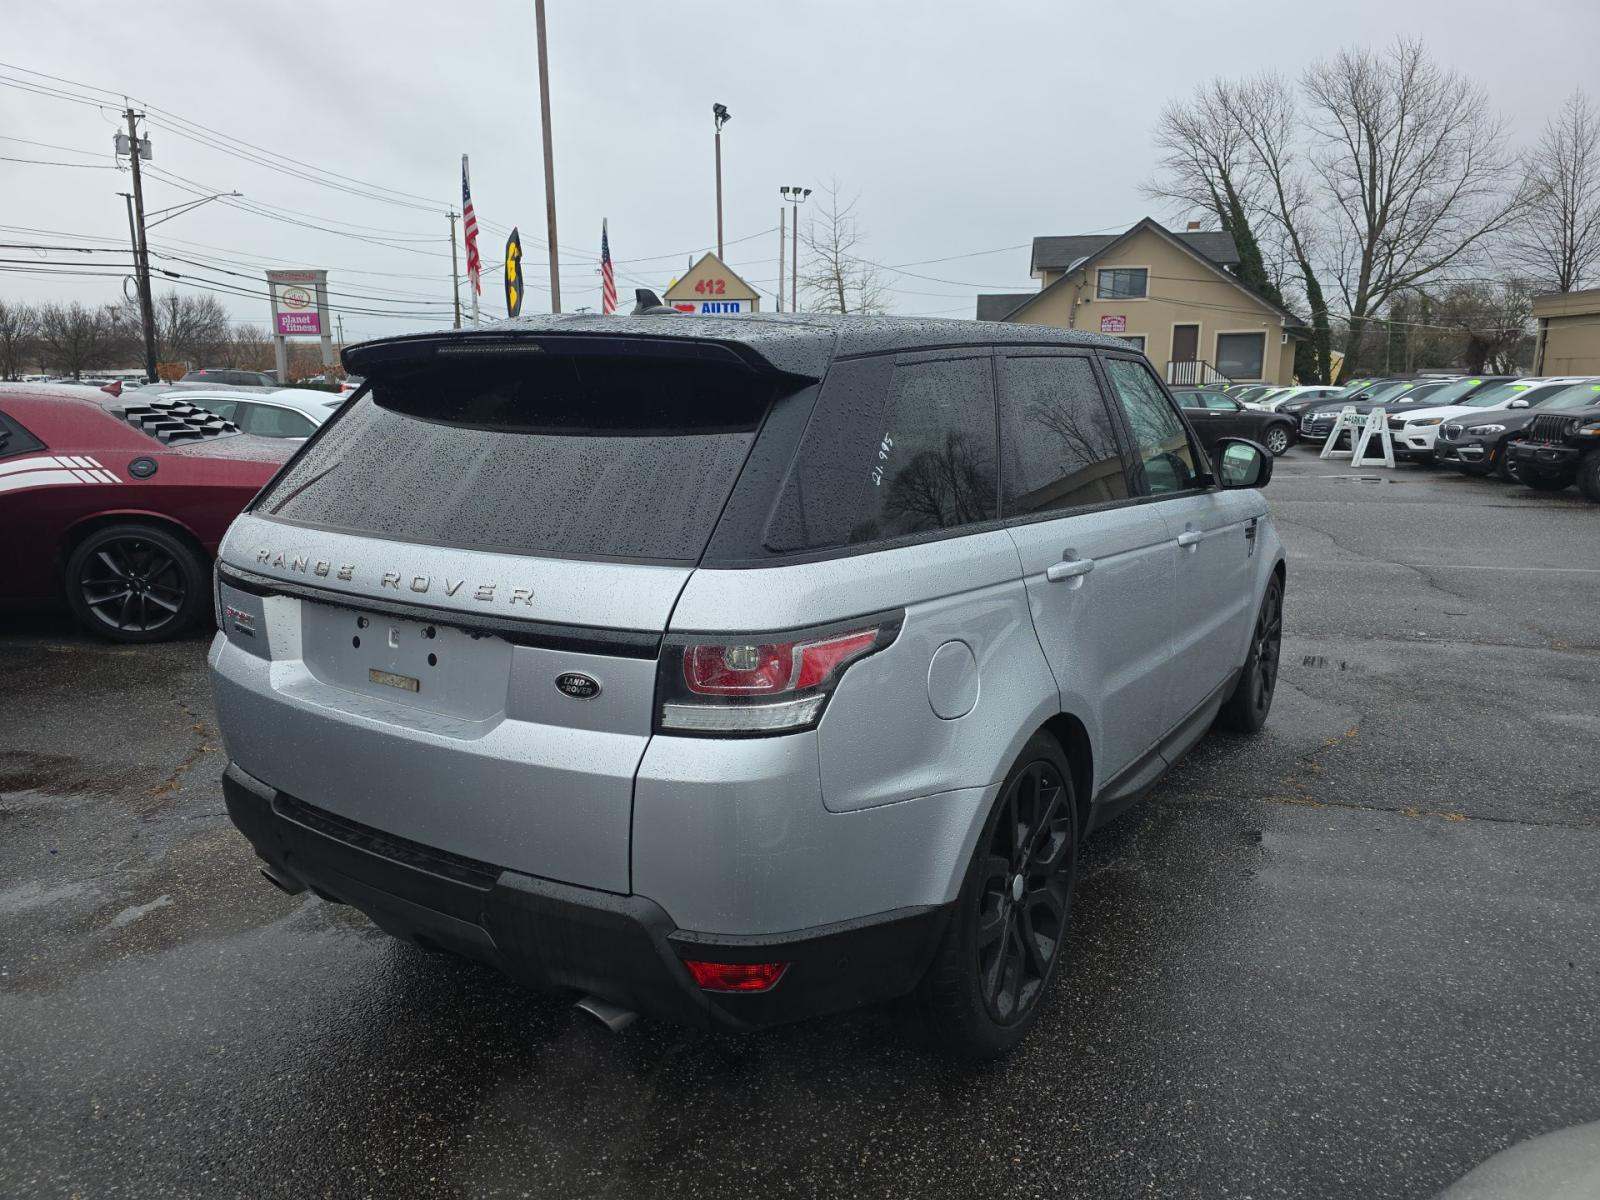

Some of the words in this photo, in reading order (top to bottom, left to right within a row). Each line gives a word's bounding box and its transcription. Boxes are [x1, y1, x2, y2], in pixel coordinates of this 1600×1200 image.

[694, 279, 726, 295] 412
[701, 302, 740, 313] AUTO
[282, 314, 311, 325] planet
[286, 323, 317, 332] fitness
[256, 549, 355, 582] RANGE
[381, 571, 535, 607] ROVER
[563, 677, 586, 687] LAND
[564, 685, 593, 696] ROVER
